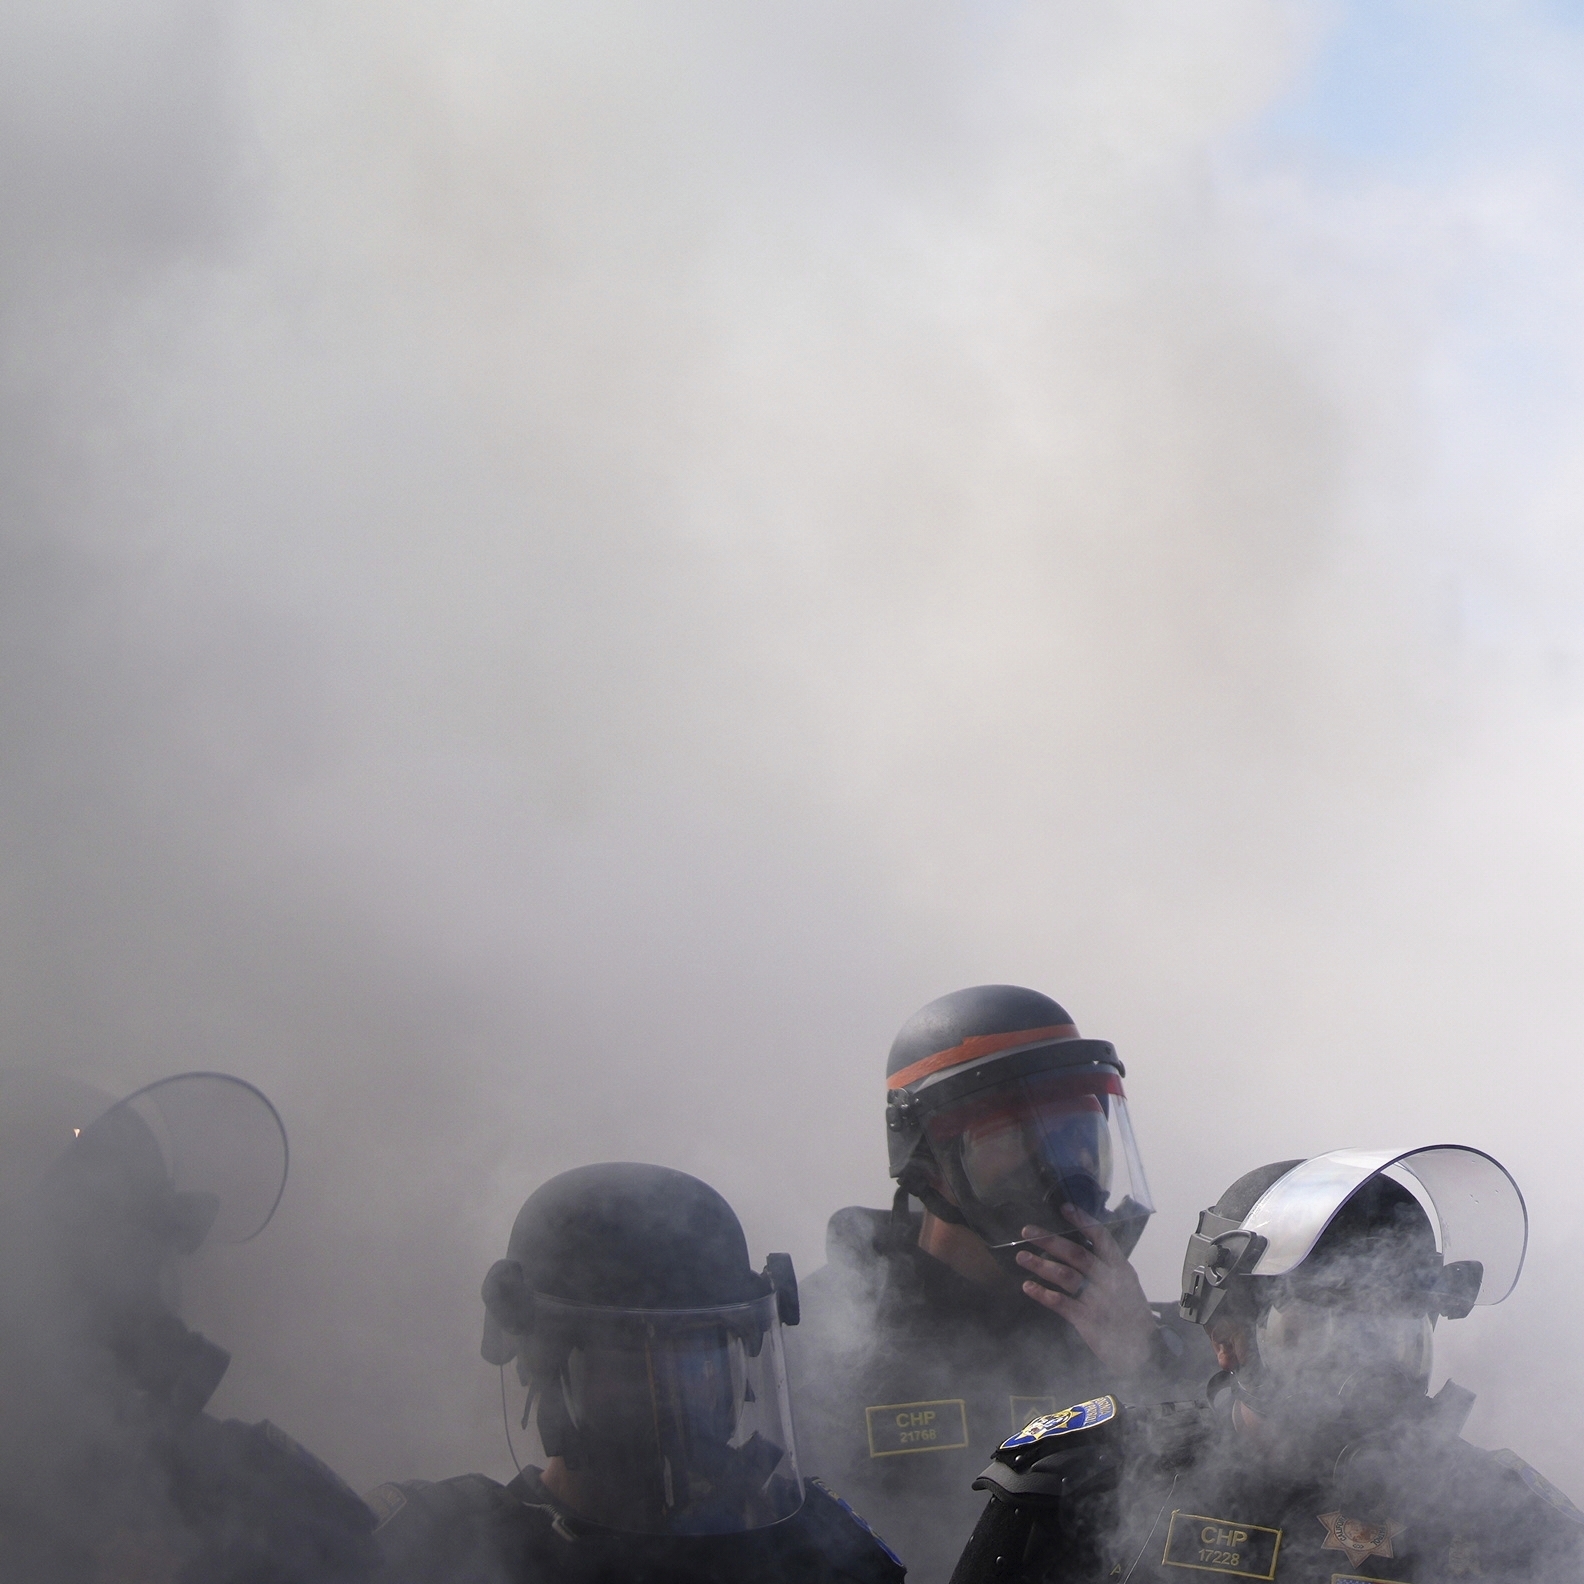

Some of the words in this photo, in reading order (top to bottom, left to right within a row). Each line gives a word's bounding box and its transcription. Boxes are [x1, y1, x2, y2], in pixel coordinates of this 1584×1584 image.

[895, 1411, 936, 1428] CHP
[900, 1429, 937, 1443] 21768
[1201, 1526, 1247, 1547] CHP
[1199, 1549, 1240, 1566] 17228
